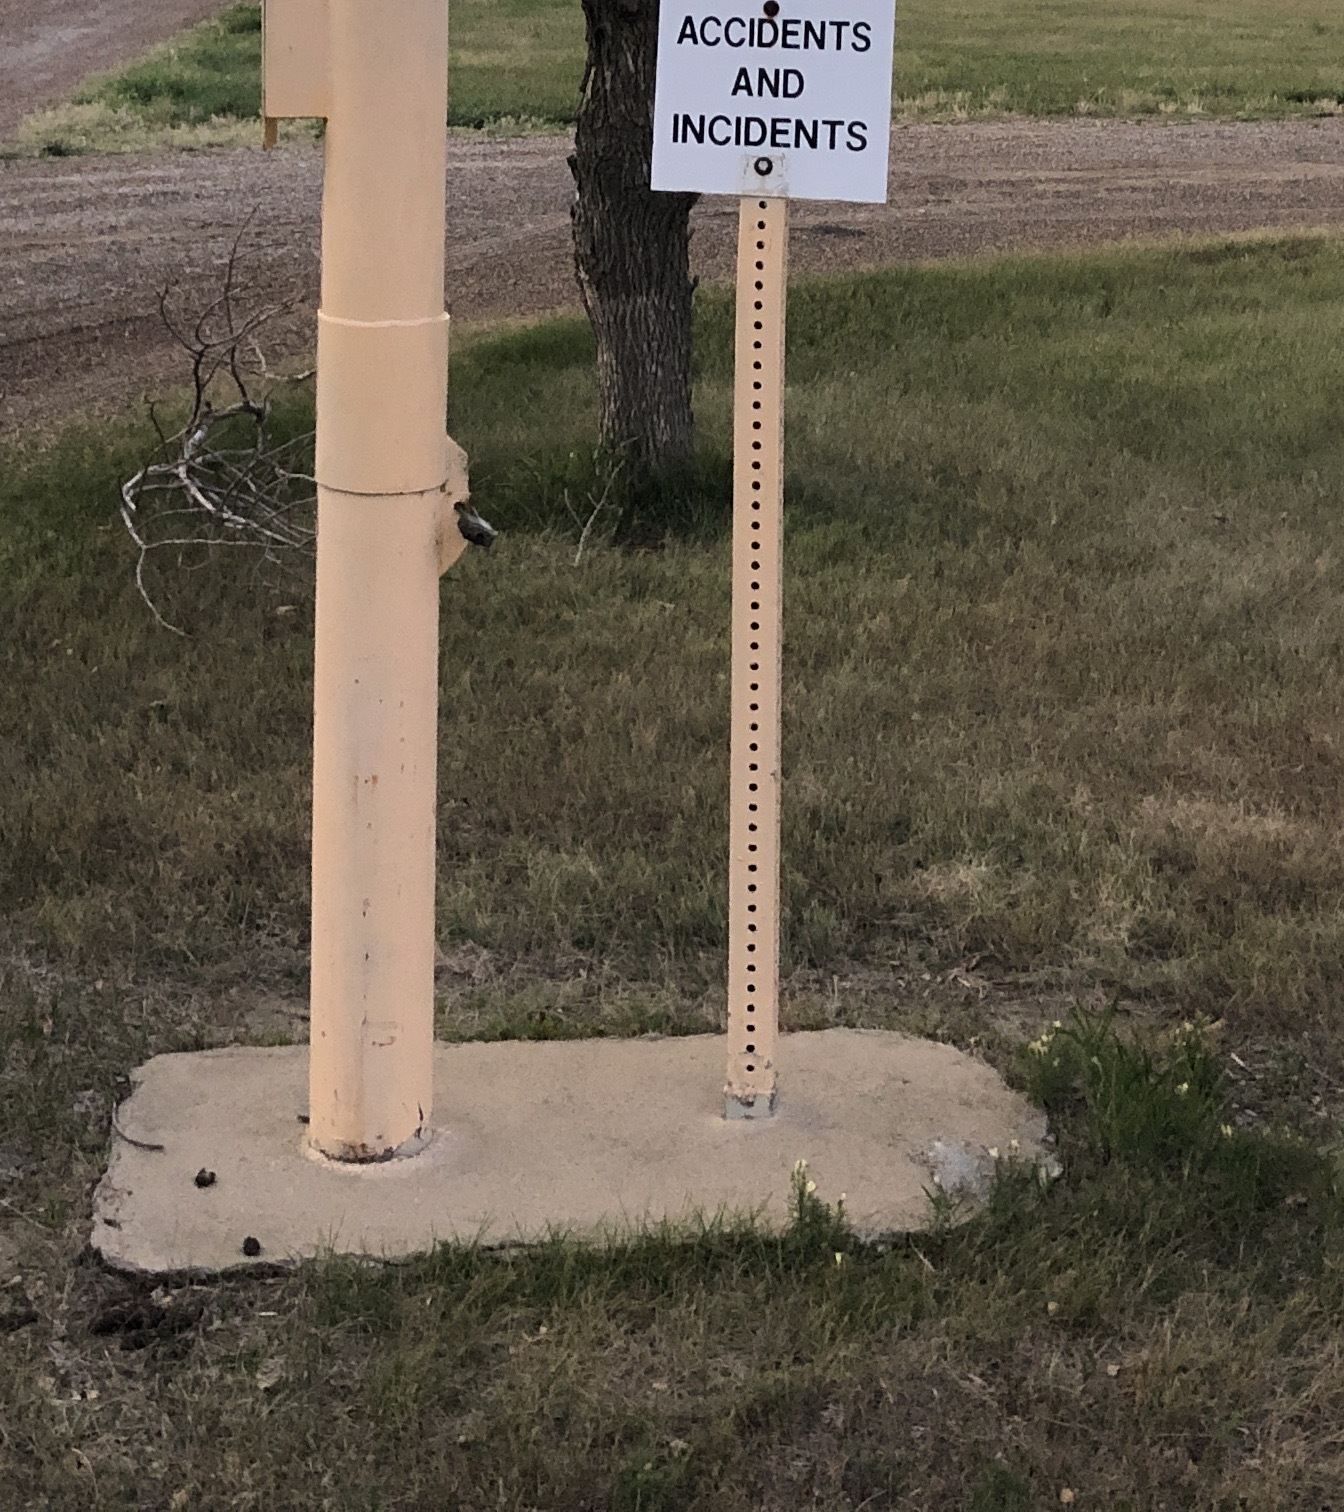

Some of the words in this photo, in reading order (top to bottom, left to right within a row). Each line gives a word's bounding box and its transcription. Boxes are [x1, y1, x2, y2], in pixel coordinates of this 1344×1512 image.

[677, 15, 872, 53] ACCIDENTS
[731, 67, 805, 99] AND
[672, 113, 868, 152] INCIDENTS
